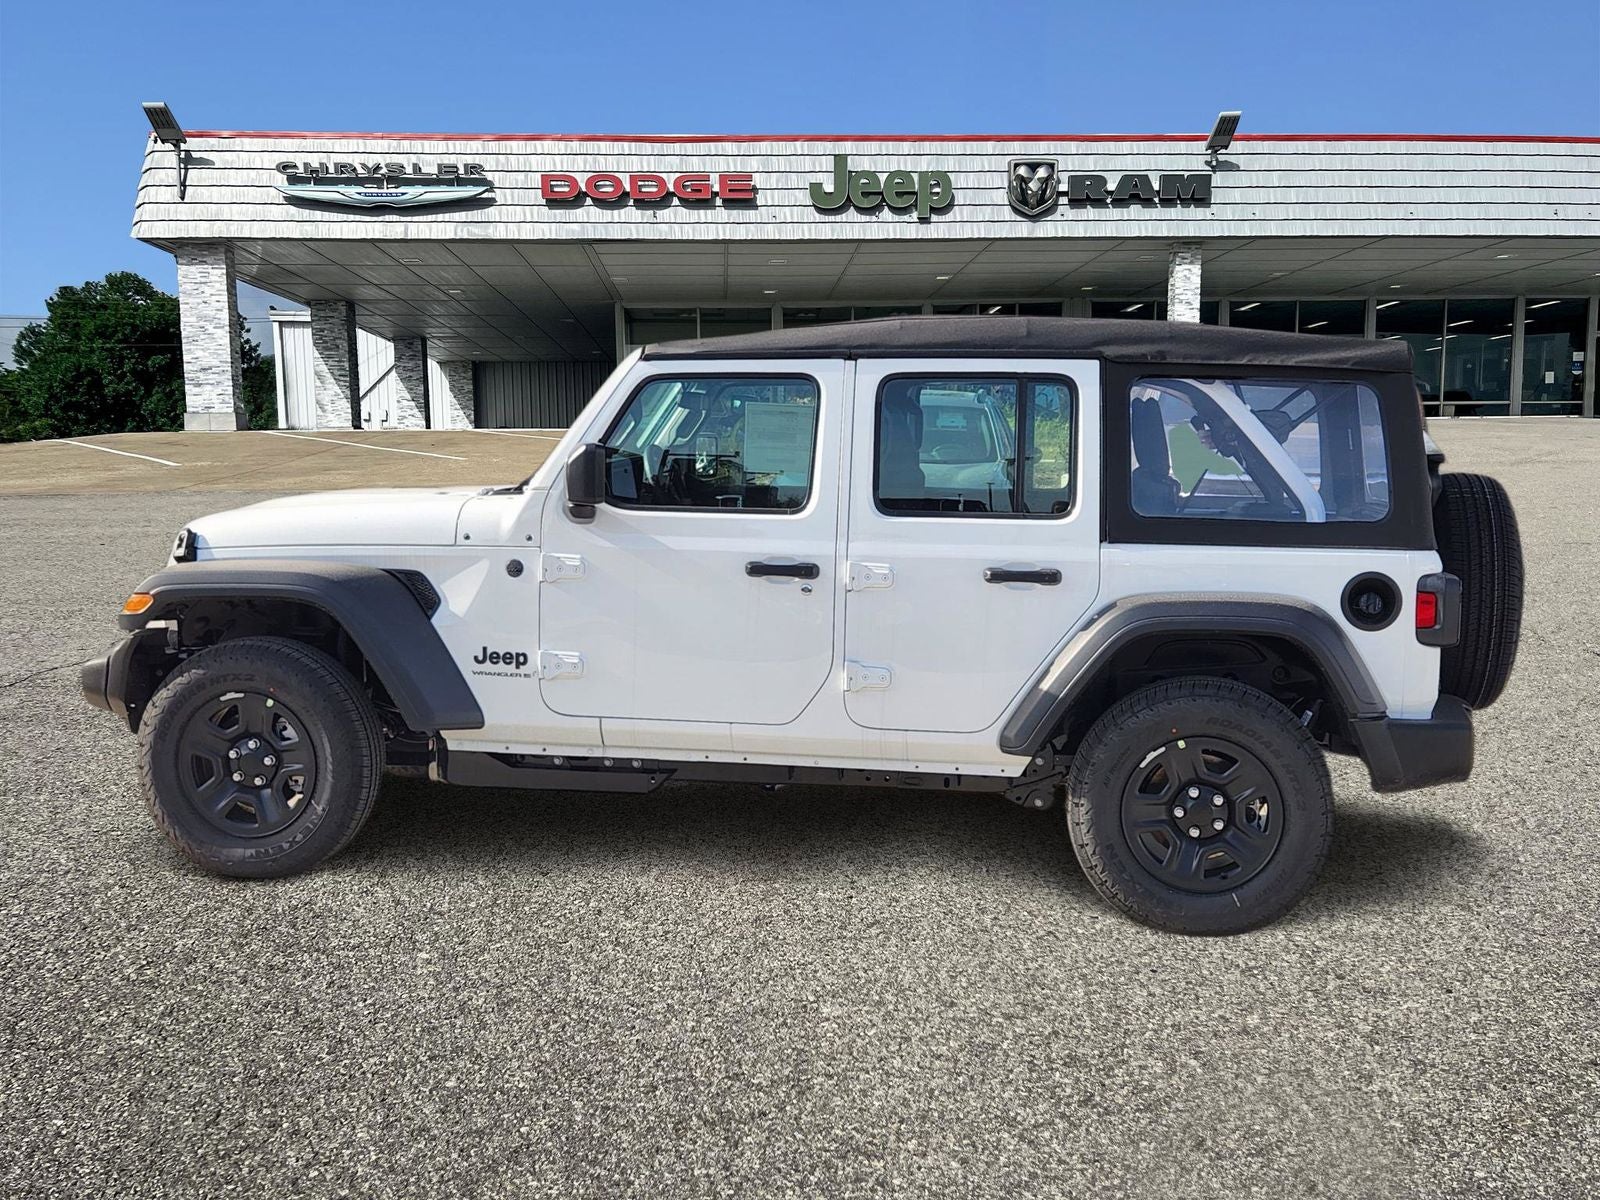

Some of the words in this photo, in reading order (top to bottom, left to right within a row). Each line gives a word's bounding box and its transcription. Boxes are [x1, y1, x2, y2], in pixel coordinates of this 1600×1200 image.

[275, 161, 486, 177] CHRYSLER
[541, 174, 754, 199] DODGE
[809, 154, 952, 218] Jeep
[1068, 174, 1212, 199] RAM
[473, 646, 528, 669] Jeep
[472, 670, 522, 678] WRANGLER
